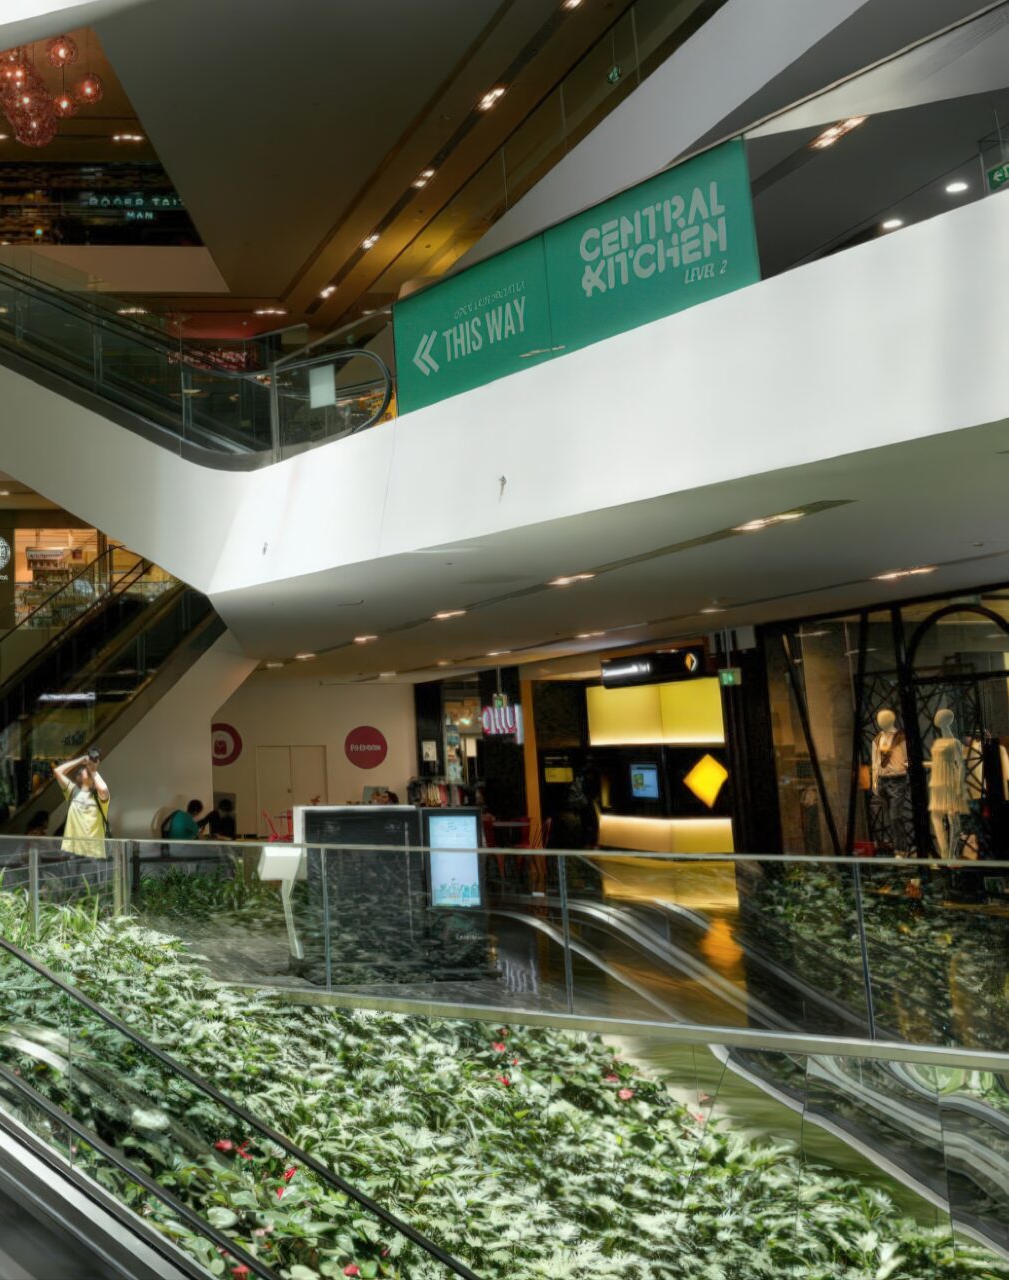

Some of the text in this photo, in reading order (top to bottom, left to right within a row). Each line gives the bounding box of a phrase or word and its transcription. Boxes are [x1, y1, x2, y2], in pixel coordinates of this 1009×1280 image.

[579, 181, 726, 262] CENTRAL
[581, 216, 728, 298] KITCHEN
[683, 259, 728, 285] LEVEL 2
[442, 316, 483, 363] THIS
[485, 295, 526, 345] WAY
